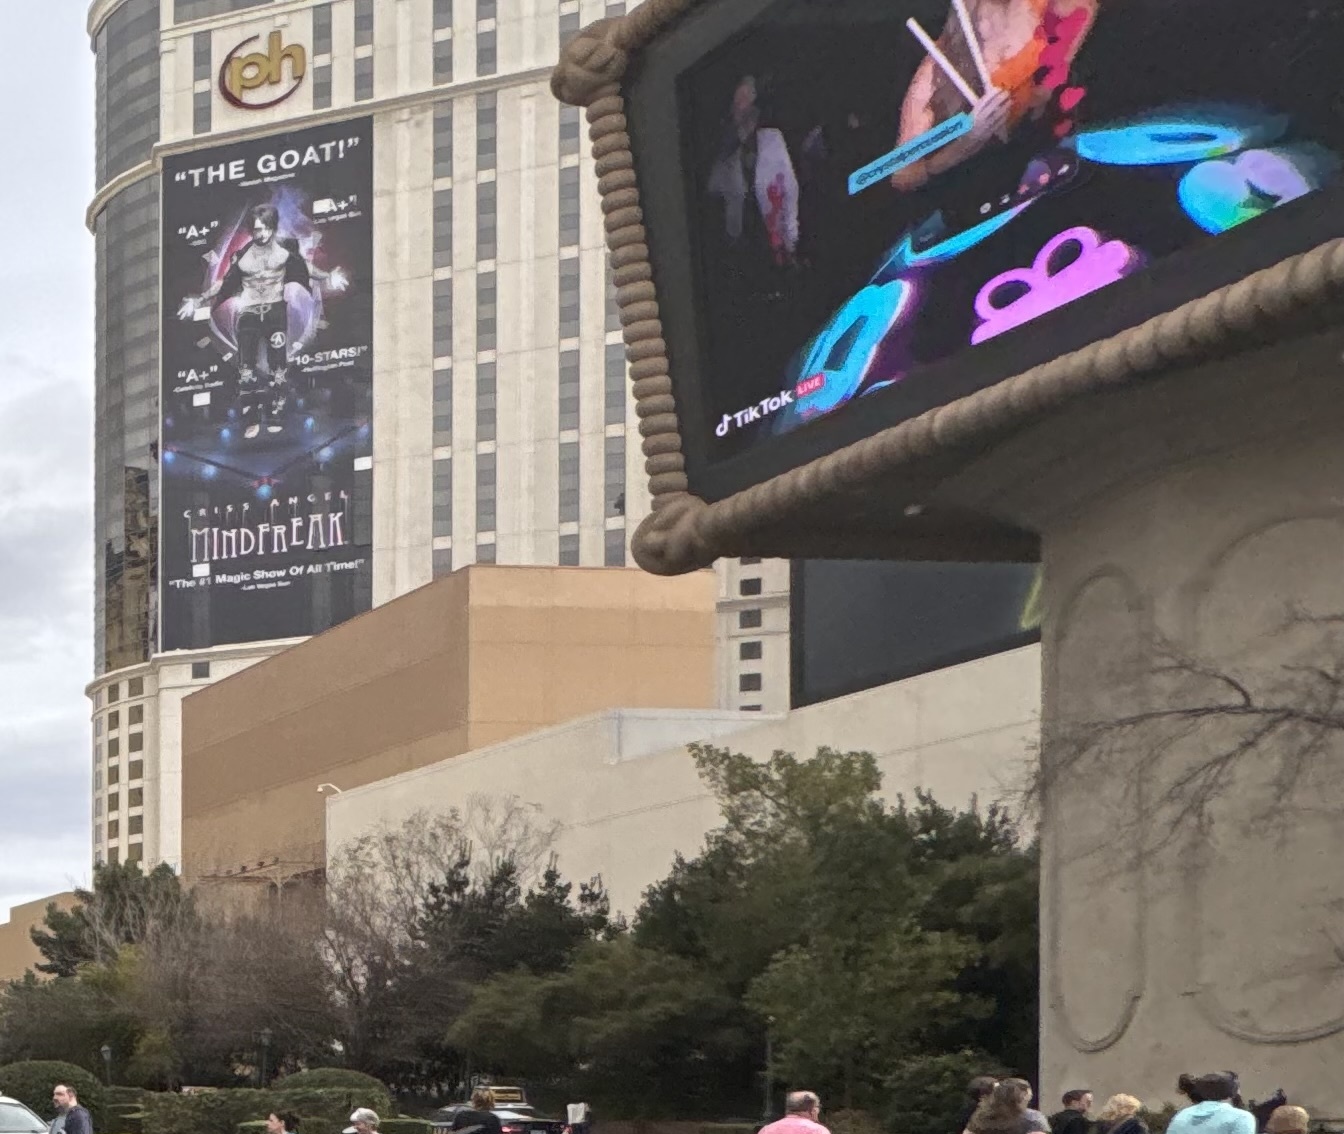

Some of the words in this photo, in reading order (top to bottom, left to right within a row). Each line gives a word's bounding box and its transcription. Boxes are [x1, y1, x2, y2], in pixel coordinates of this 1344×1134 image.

[229, 30, 306, 101] ph
[175, 159, 246, 187] “THE
[257, 137, 360, 174] GOAT!”
[178, 221, 219, 239] “A+”
[177, 364, 219, 383] “A+”
[733, 390, 794, 427] TikTok
[797, 376, 821, 395] LIVE
[183, 503, 250, 518] CRISS
[270, 490, 348, 507] ANGEL
[191, 512, 344, 562] MINDFREAK
[215, 571, 251, 585] Magic
[253, 568, 286, 581] Show
[289, 565, 305, 576] Of
[306, 563, 323, 574] All
